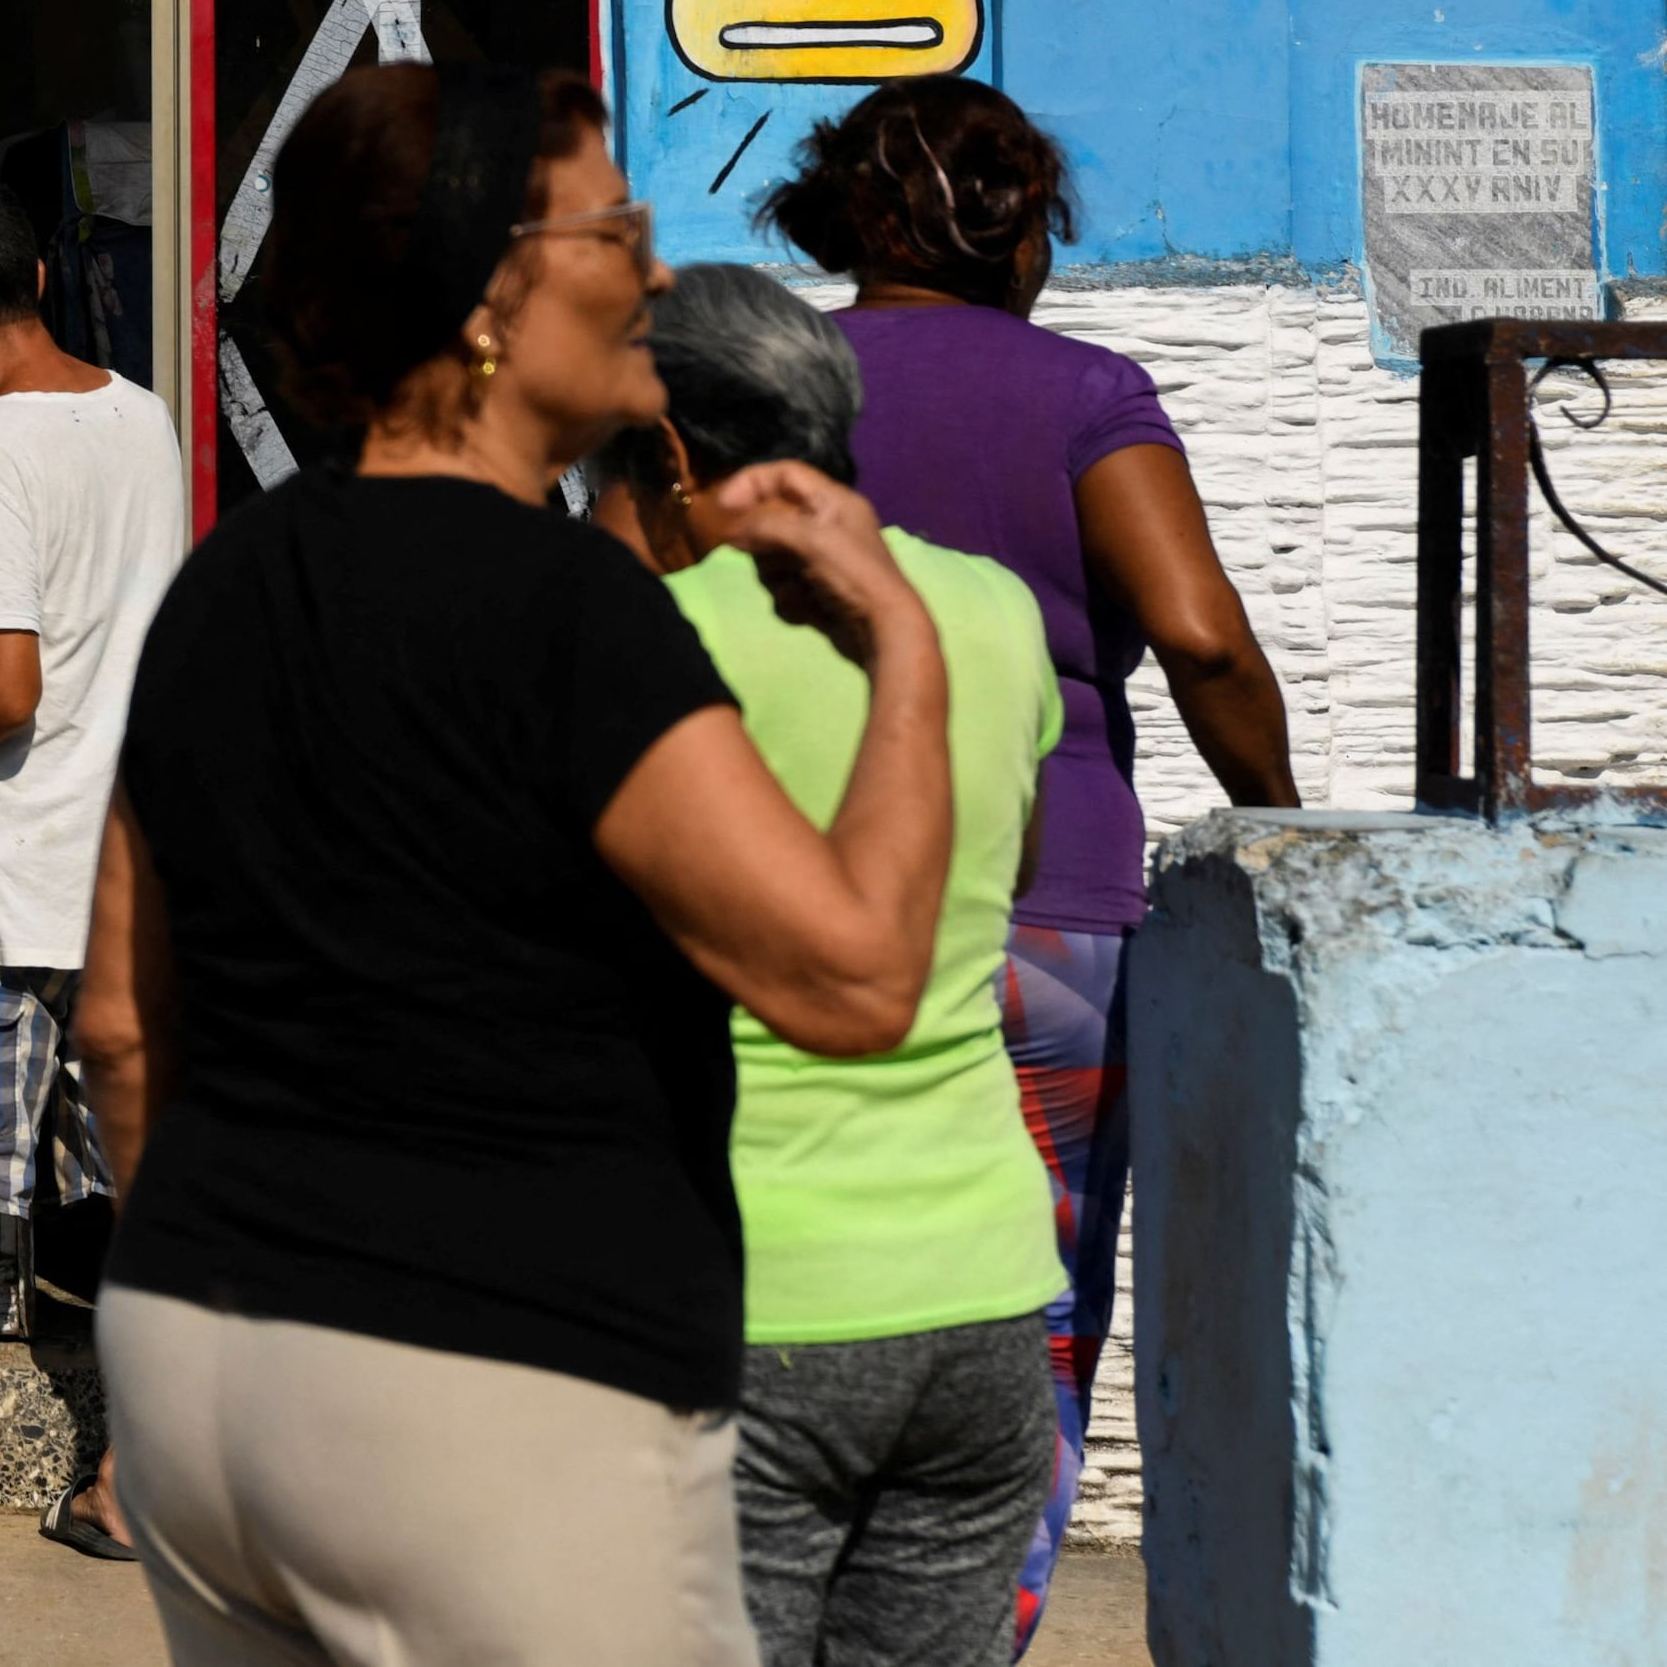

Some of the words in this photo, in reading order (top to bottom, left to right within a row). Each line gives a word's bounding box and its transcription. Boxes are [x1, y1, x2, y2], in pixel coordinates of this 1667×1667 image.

[1371, 101, 1539, 130] HOMENAJE
[1548, 101, 1587, 129] AL
[1492, 139, 1531, 166] EN
[1541, 139, 1578, 166] SU
[1390, 175, 1482, 203] XXXV
[1491, 175, 1561, 202] ANIV
